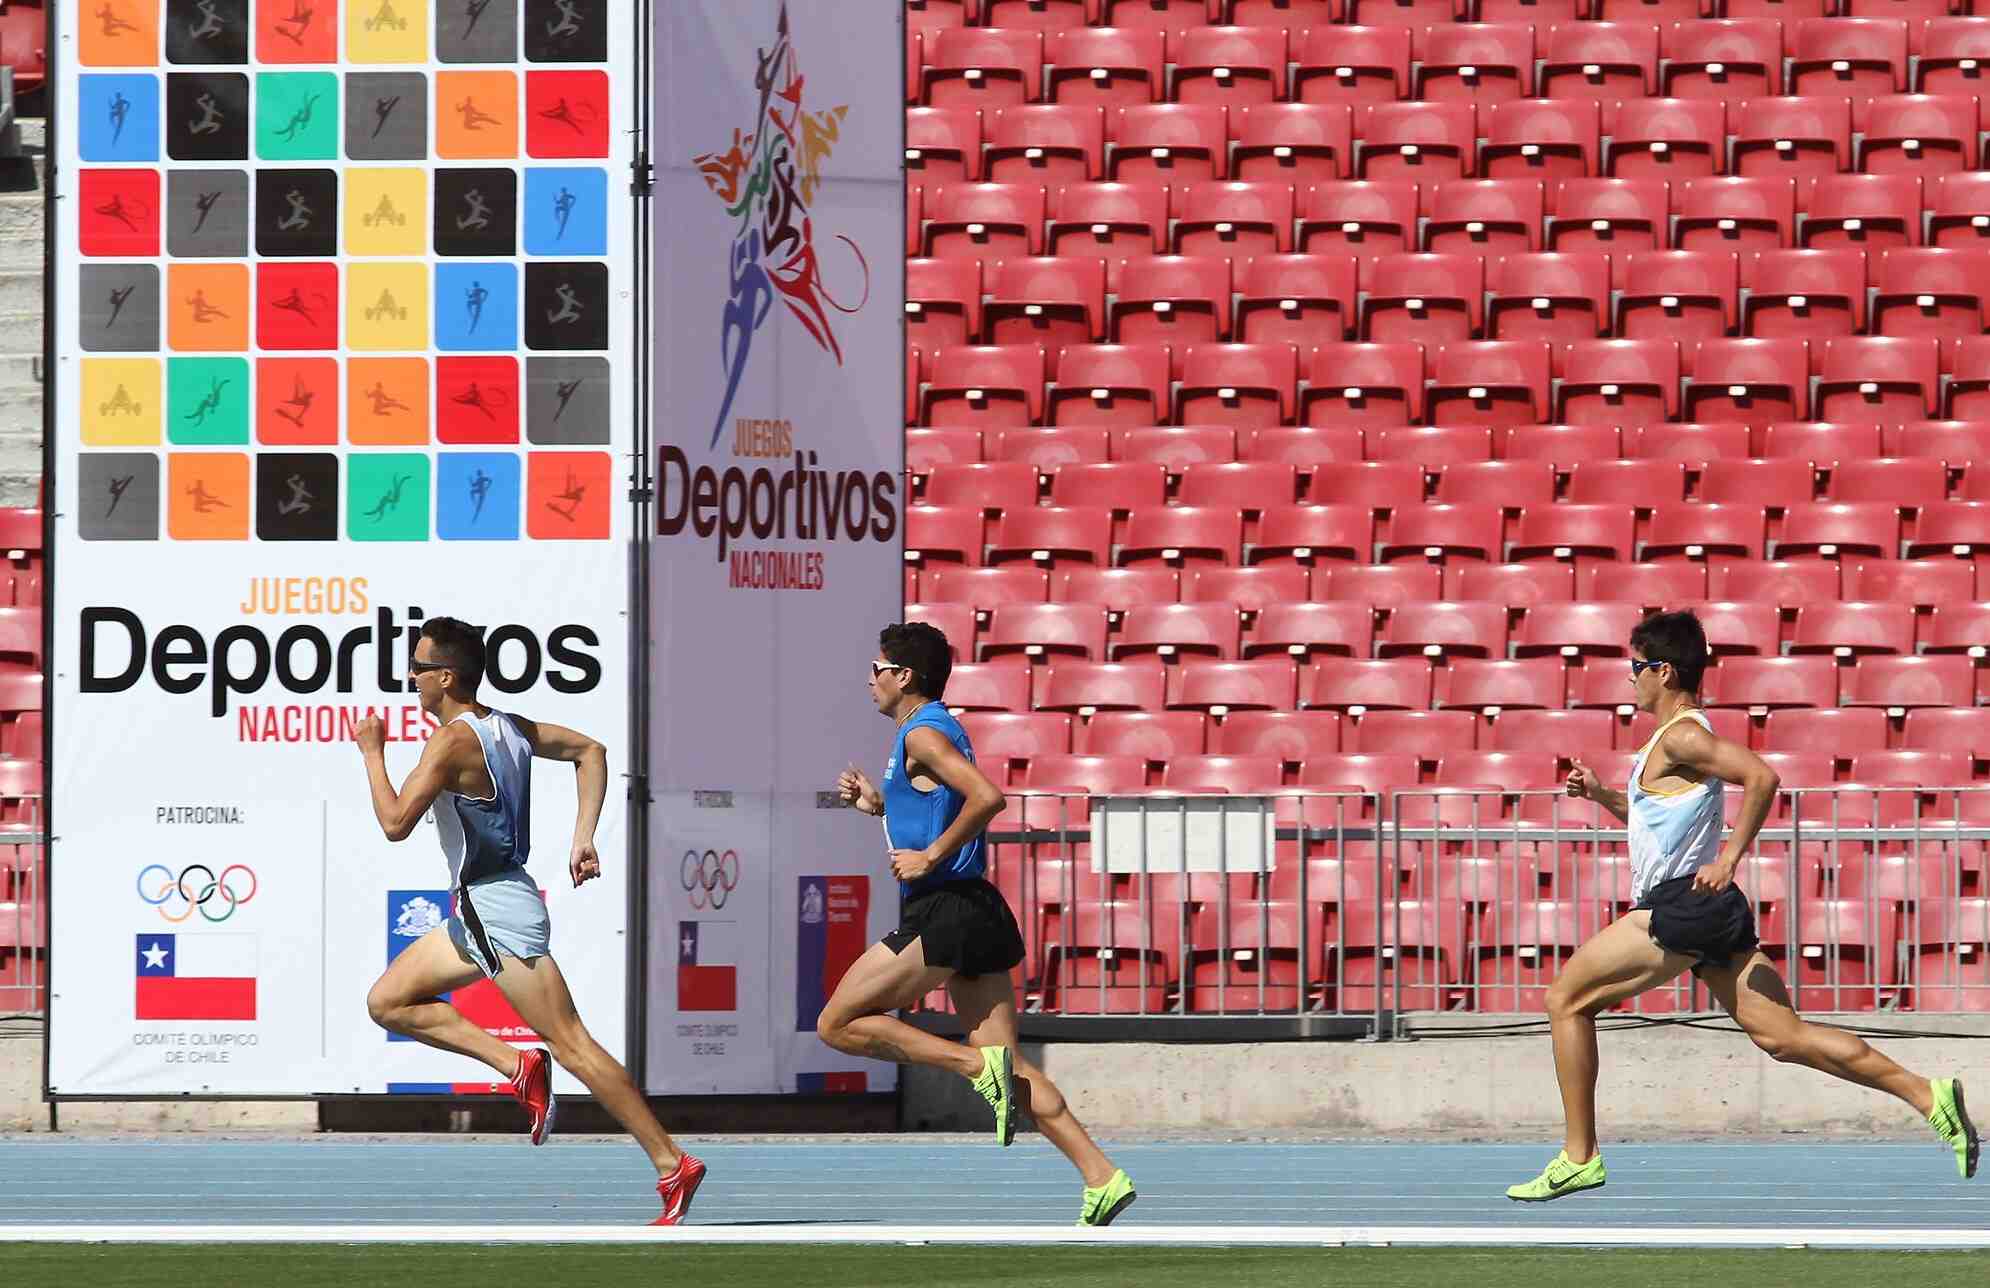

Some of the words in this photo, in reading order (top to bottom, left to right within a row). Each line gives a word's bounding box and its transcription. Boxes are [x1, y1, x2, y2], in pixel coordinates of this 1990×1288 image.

[735, 420, 793, 458] JUEGOS
[656, 444, 897, 563] Deportivos
[729, 551, 825, 590] NACIONALES
[241, 577, 368, 614] JUEGOS
[156, 806, 245, 824] PATROCINA:
[165, 1050, 186, 1063] DE
[188, 1050, 230, 1063] CHILE
